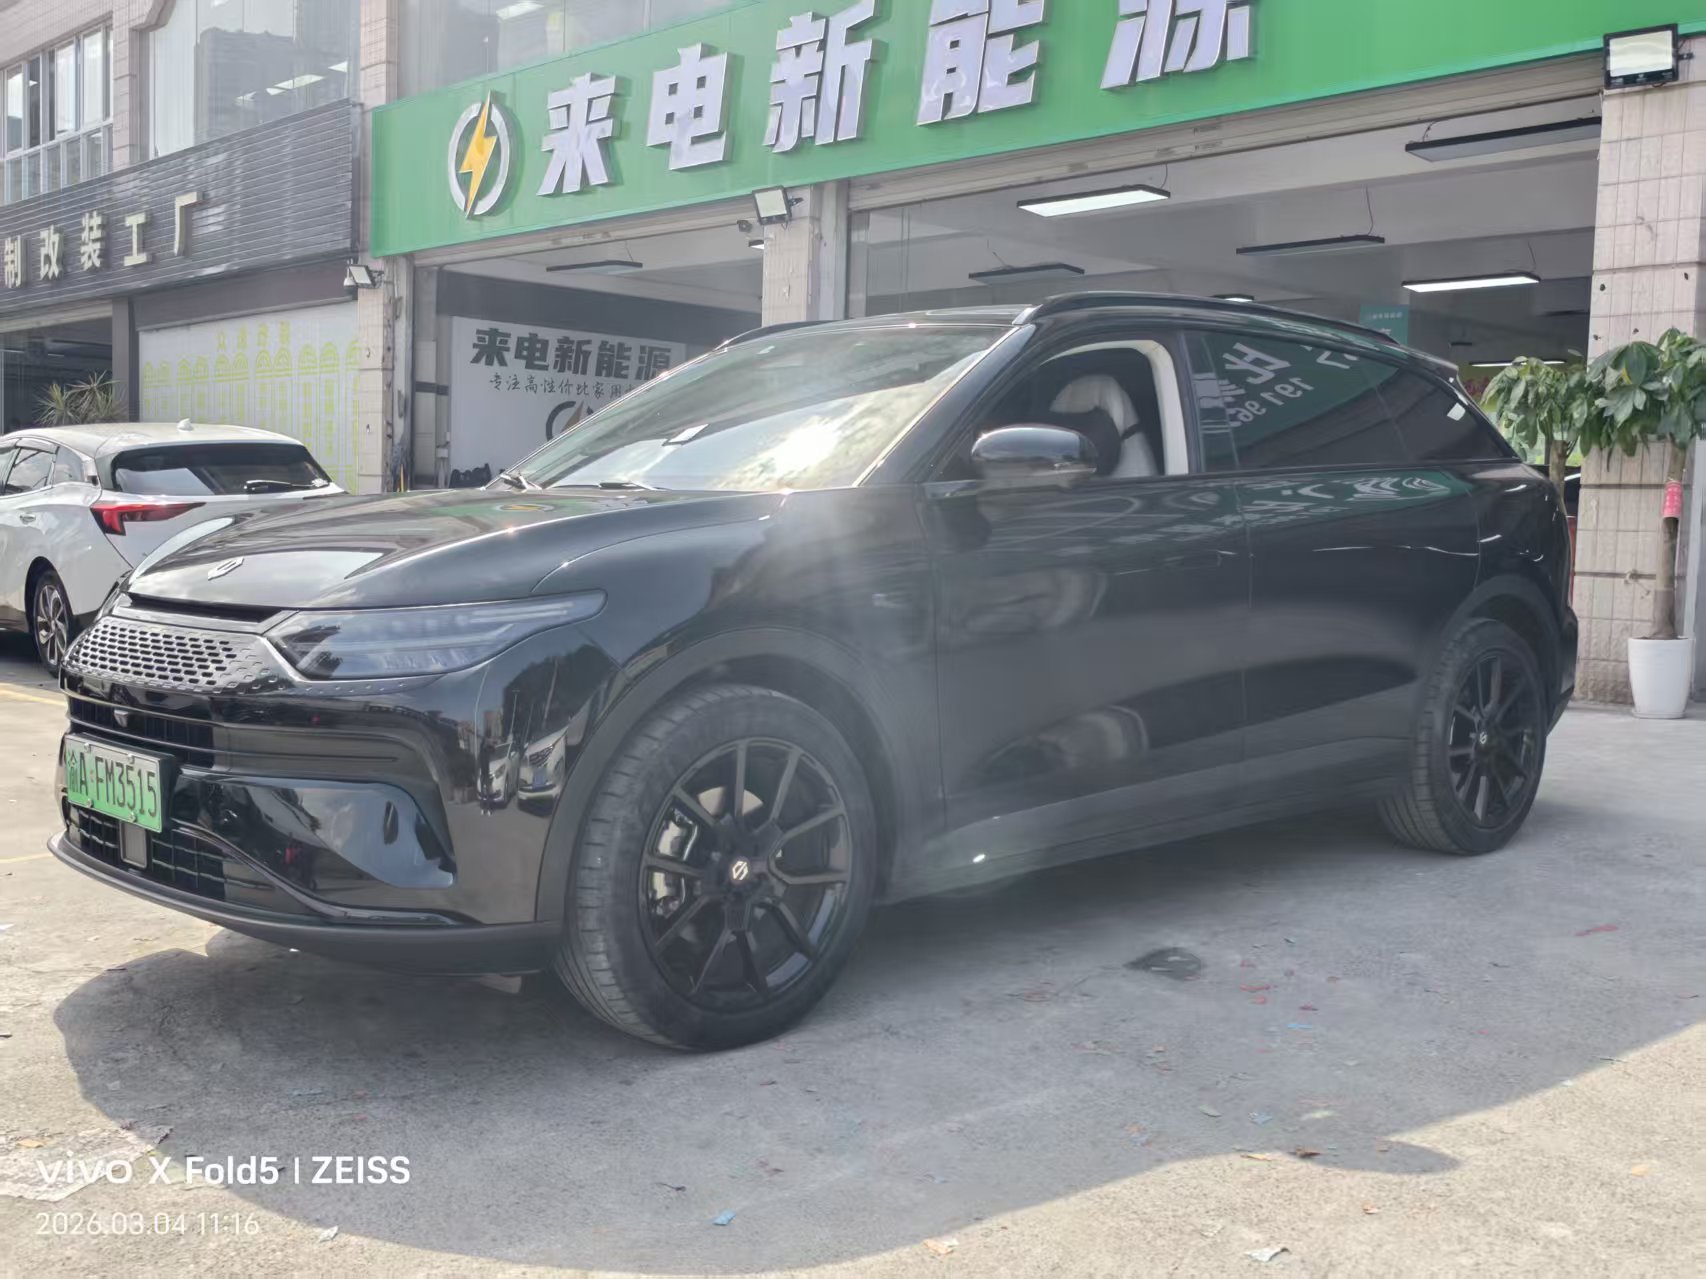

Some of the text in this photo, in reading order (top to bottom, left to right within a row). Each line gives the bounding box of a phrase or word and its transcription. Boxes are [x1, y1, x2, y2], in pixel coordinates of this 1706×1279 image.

[4, 191, 198, 288] 制改装工厂
[470, 327, 672, 381] 来电新能源
